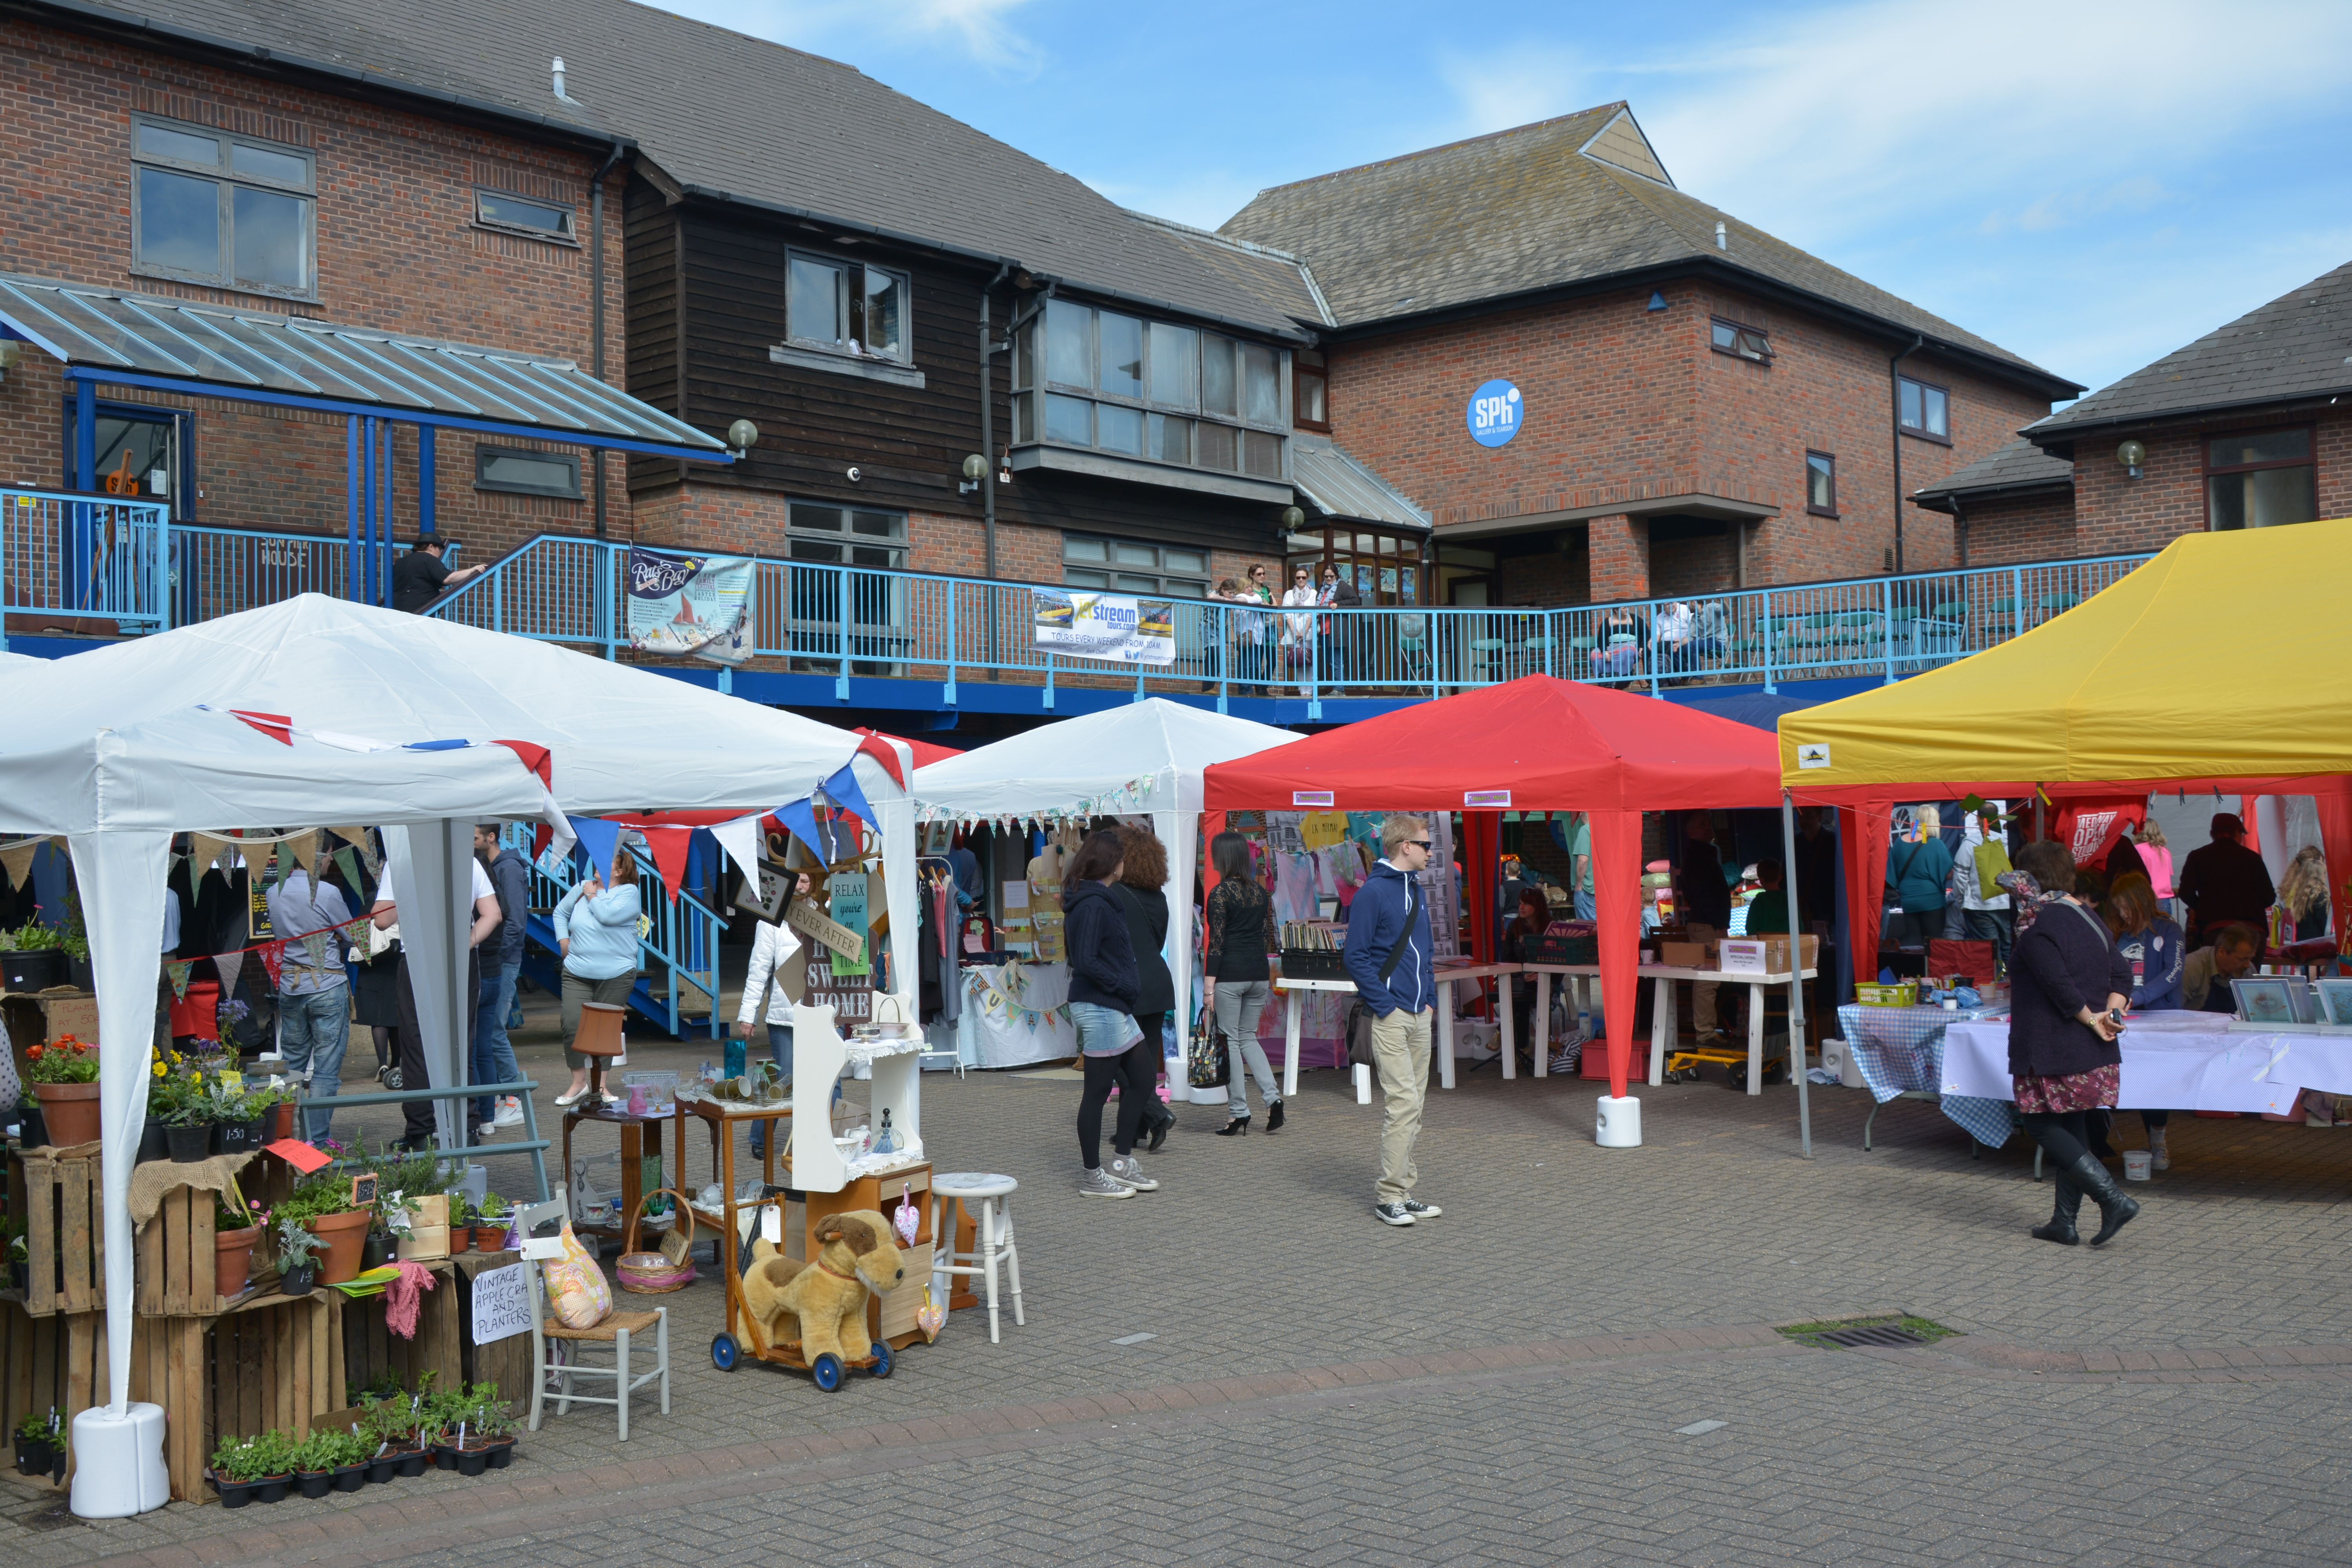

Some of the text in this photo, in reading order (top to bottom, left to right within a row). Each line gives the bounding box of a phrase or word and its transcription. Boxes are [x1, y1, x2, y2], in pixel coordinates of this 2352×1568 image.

[1476, 395, 1513, 428] SPh
[1496, 425, 1513, 433] TEAROOM
[111, 477, 132, 493] Sh
[261, 550, 306, 568] HOUSE
[632, 561, 689, 591] Rats Bay
[1107, 621, 1135, 631] tours.com
[1051, 632, 1161, 650] TOURS EVERY WEEKEND FROM 10AM
[1140, 653, 1173, 661] @jetstreamtours
[1312, 824, 1319, 834] EX
[835, 884, 865, 897] RELAX
[840, 902, 862, 916] you're
[796, 909, 822, 935] EVER
[822, 926, 855, 954] AFTER
[59, 1003, 96, 1013] PLANTS
[813, 993, 869, 1017] HOME
[475, 1267, 519, 1292] VINTAGE
[475, 1288, 505, 1309] APPLE
[492, 1300, 514, 1315] AND
[476, 1307, 531, 1336] PLANTERS
